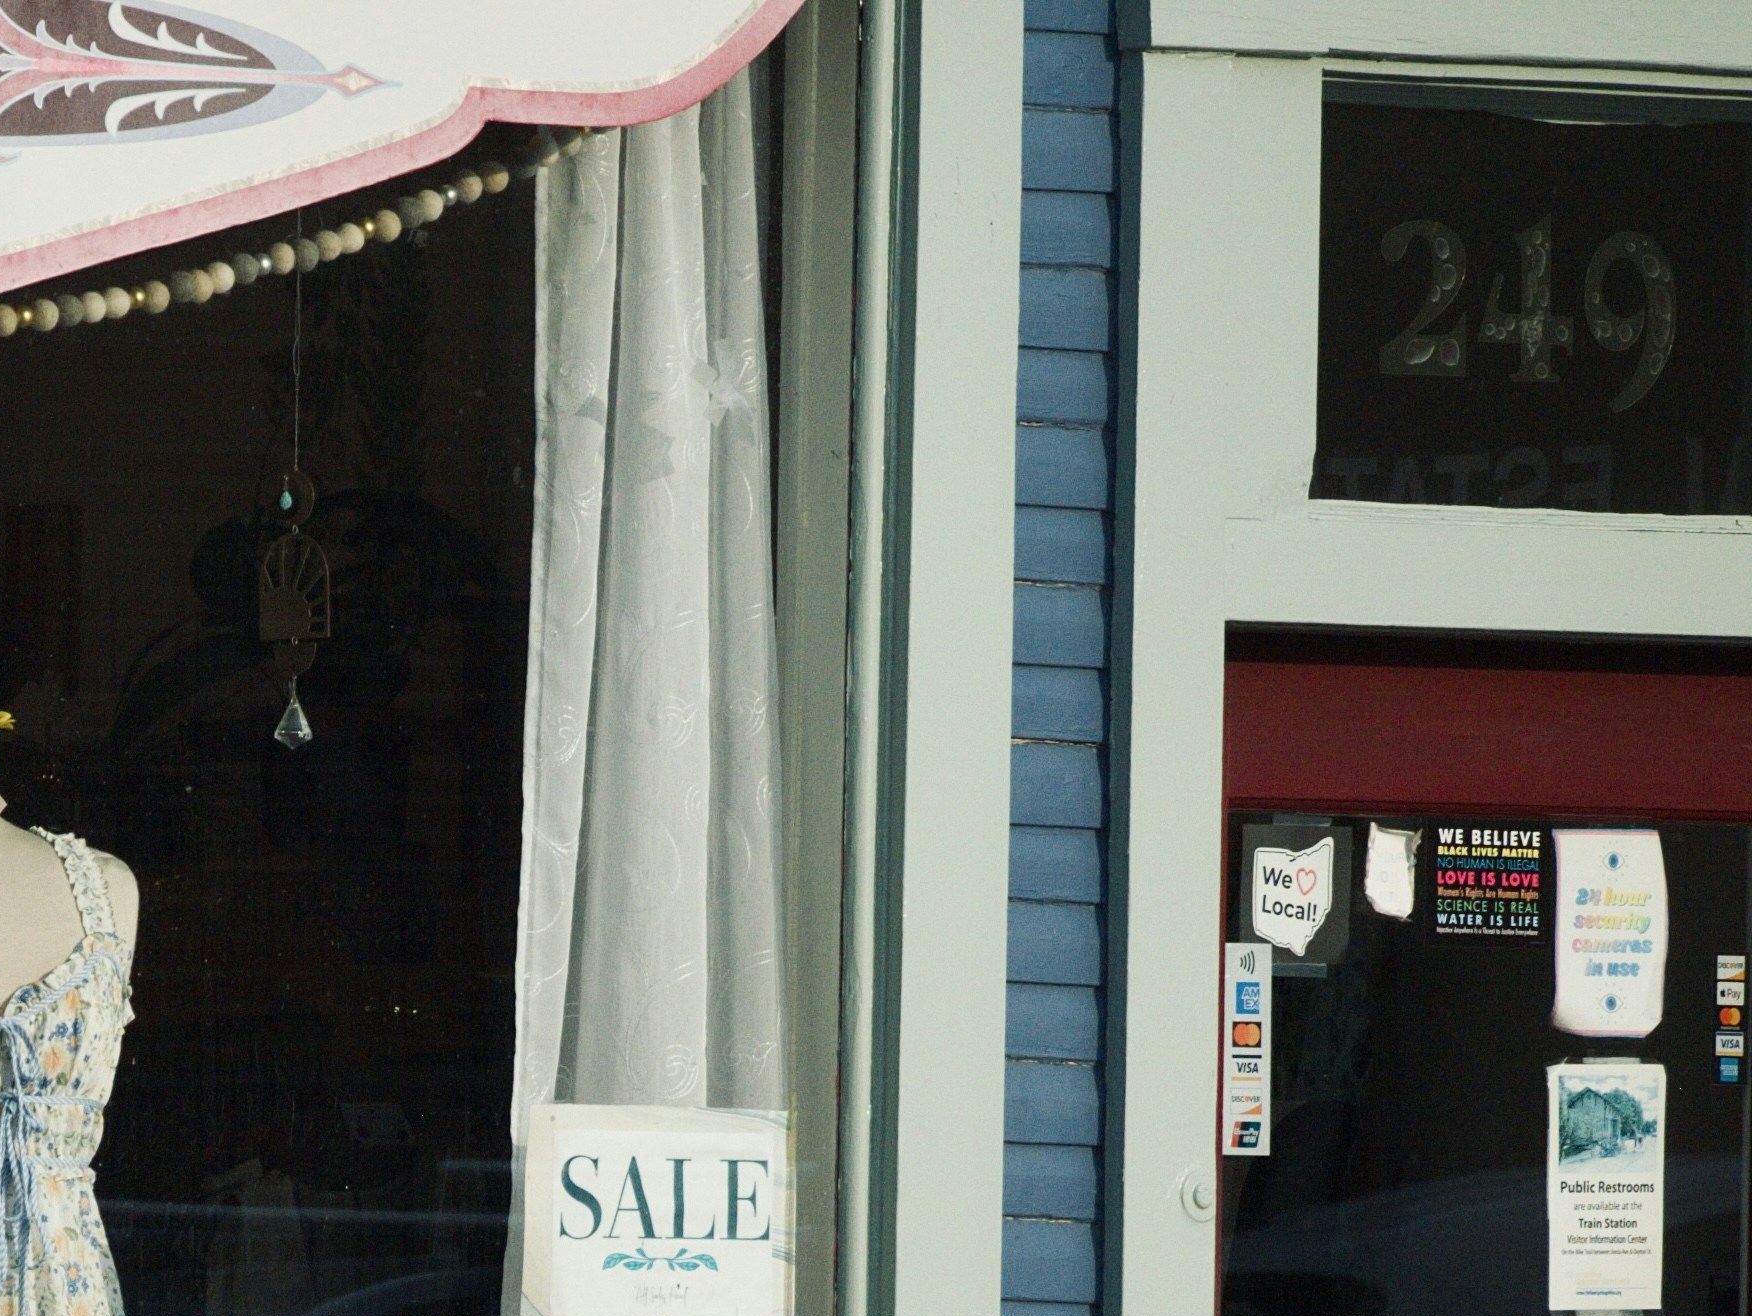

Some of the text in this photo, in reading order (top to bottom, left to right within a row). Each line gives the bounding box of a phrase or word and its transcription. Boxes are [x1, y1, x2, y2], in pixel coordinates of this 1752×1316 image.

[1379, 213, 1677, 413] 249
[1438, 828, 1541, 847] WE BELIEVE
[1437, 846, 1540, 858] BLACK LIVES MATTER
[1437, 857, 1539, 871] NO HUMAN IS ILLEGAL
[1262, 866, 1293, 889] We
[1437, 870, 1540, 887] LOVE IS LOVE
[1575, 887, 1651, 906] 24 hour
[1262, 894, 1317, 922] Local!
[1436, 900, 1539, 914] SCIENCE IS REAL
[1436, 914, 1539, 928] WATER IS LIFE
[1573, 912, 1651, 934] security
[1571, 938, 1653, 954] cameras
[1584, 959, 1641, 977] in use
[1242, 986, 1260, 999] AM
[1720, 1039, 1740, 1049] VISA
[1236, 1062, 1259, 1074] VISA
[1232, 1095, 1261, 1103] DISCOVER
[1560, 1180, 1655, 1194] Public Restrooms
[559, 1154, 771, 1241] SALE
[1574, 1202, 1642, 1211] are available at the
[1578, 1218, 1638, 1228] Train Station
[1567, 1235, 1648, 1244] Visitor Information Center
